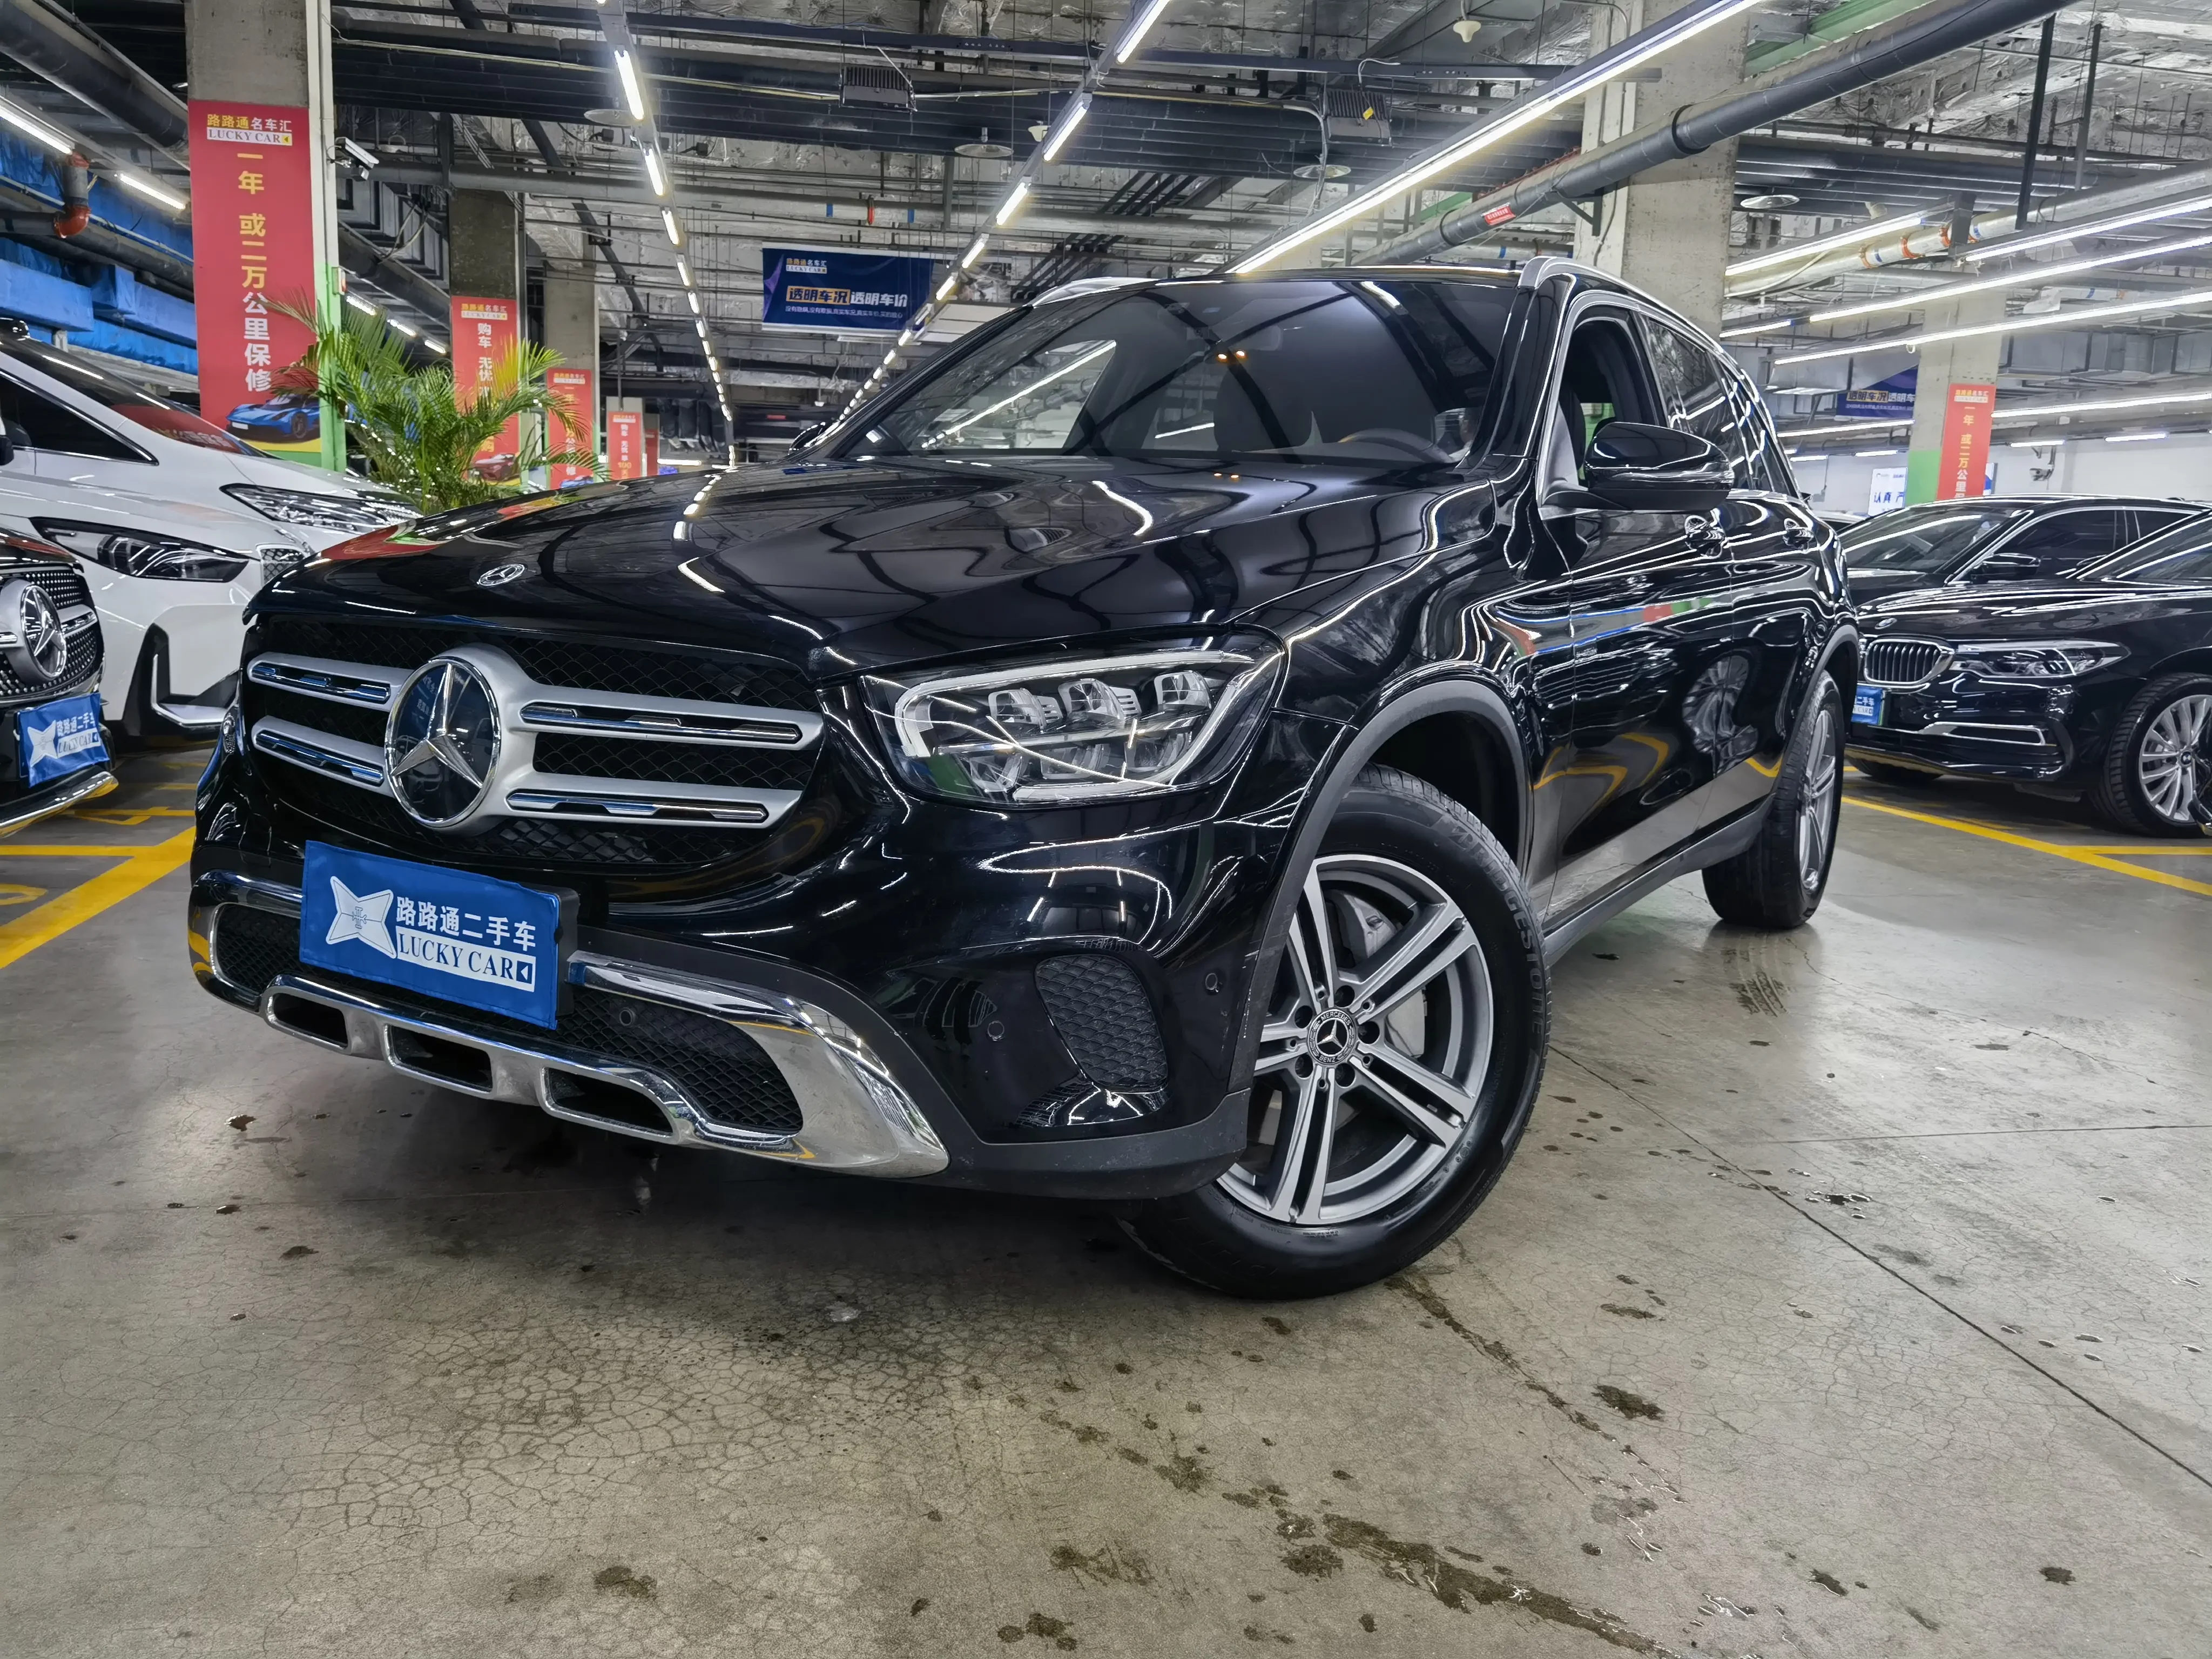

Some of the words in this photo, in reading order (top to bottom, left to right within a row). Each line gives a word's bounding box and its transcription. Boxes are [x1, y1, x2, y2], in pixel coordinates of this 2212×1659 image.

[207, 113, 292, 132] 路路通名车汇
[208, 129, 252, 141] LUCKY
[255, 132, 281, 143] CAR
[789, 288, 848, 304] 透明车况
[850, 292, 908, 307] 透明车价
[1854, 696, 1874, 706] 二手车
[396, 896, 536, 952] 路路通二手车
[398, 932, 463, 968] LUCKY
[468, 950, 514, 980] CAR
[1320, 1011, 1351, 1026] MERCEDES
